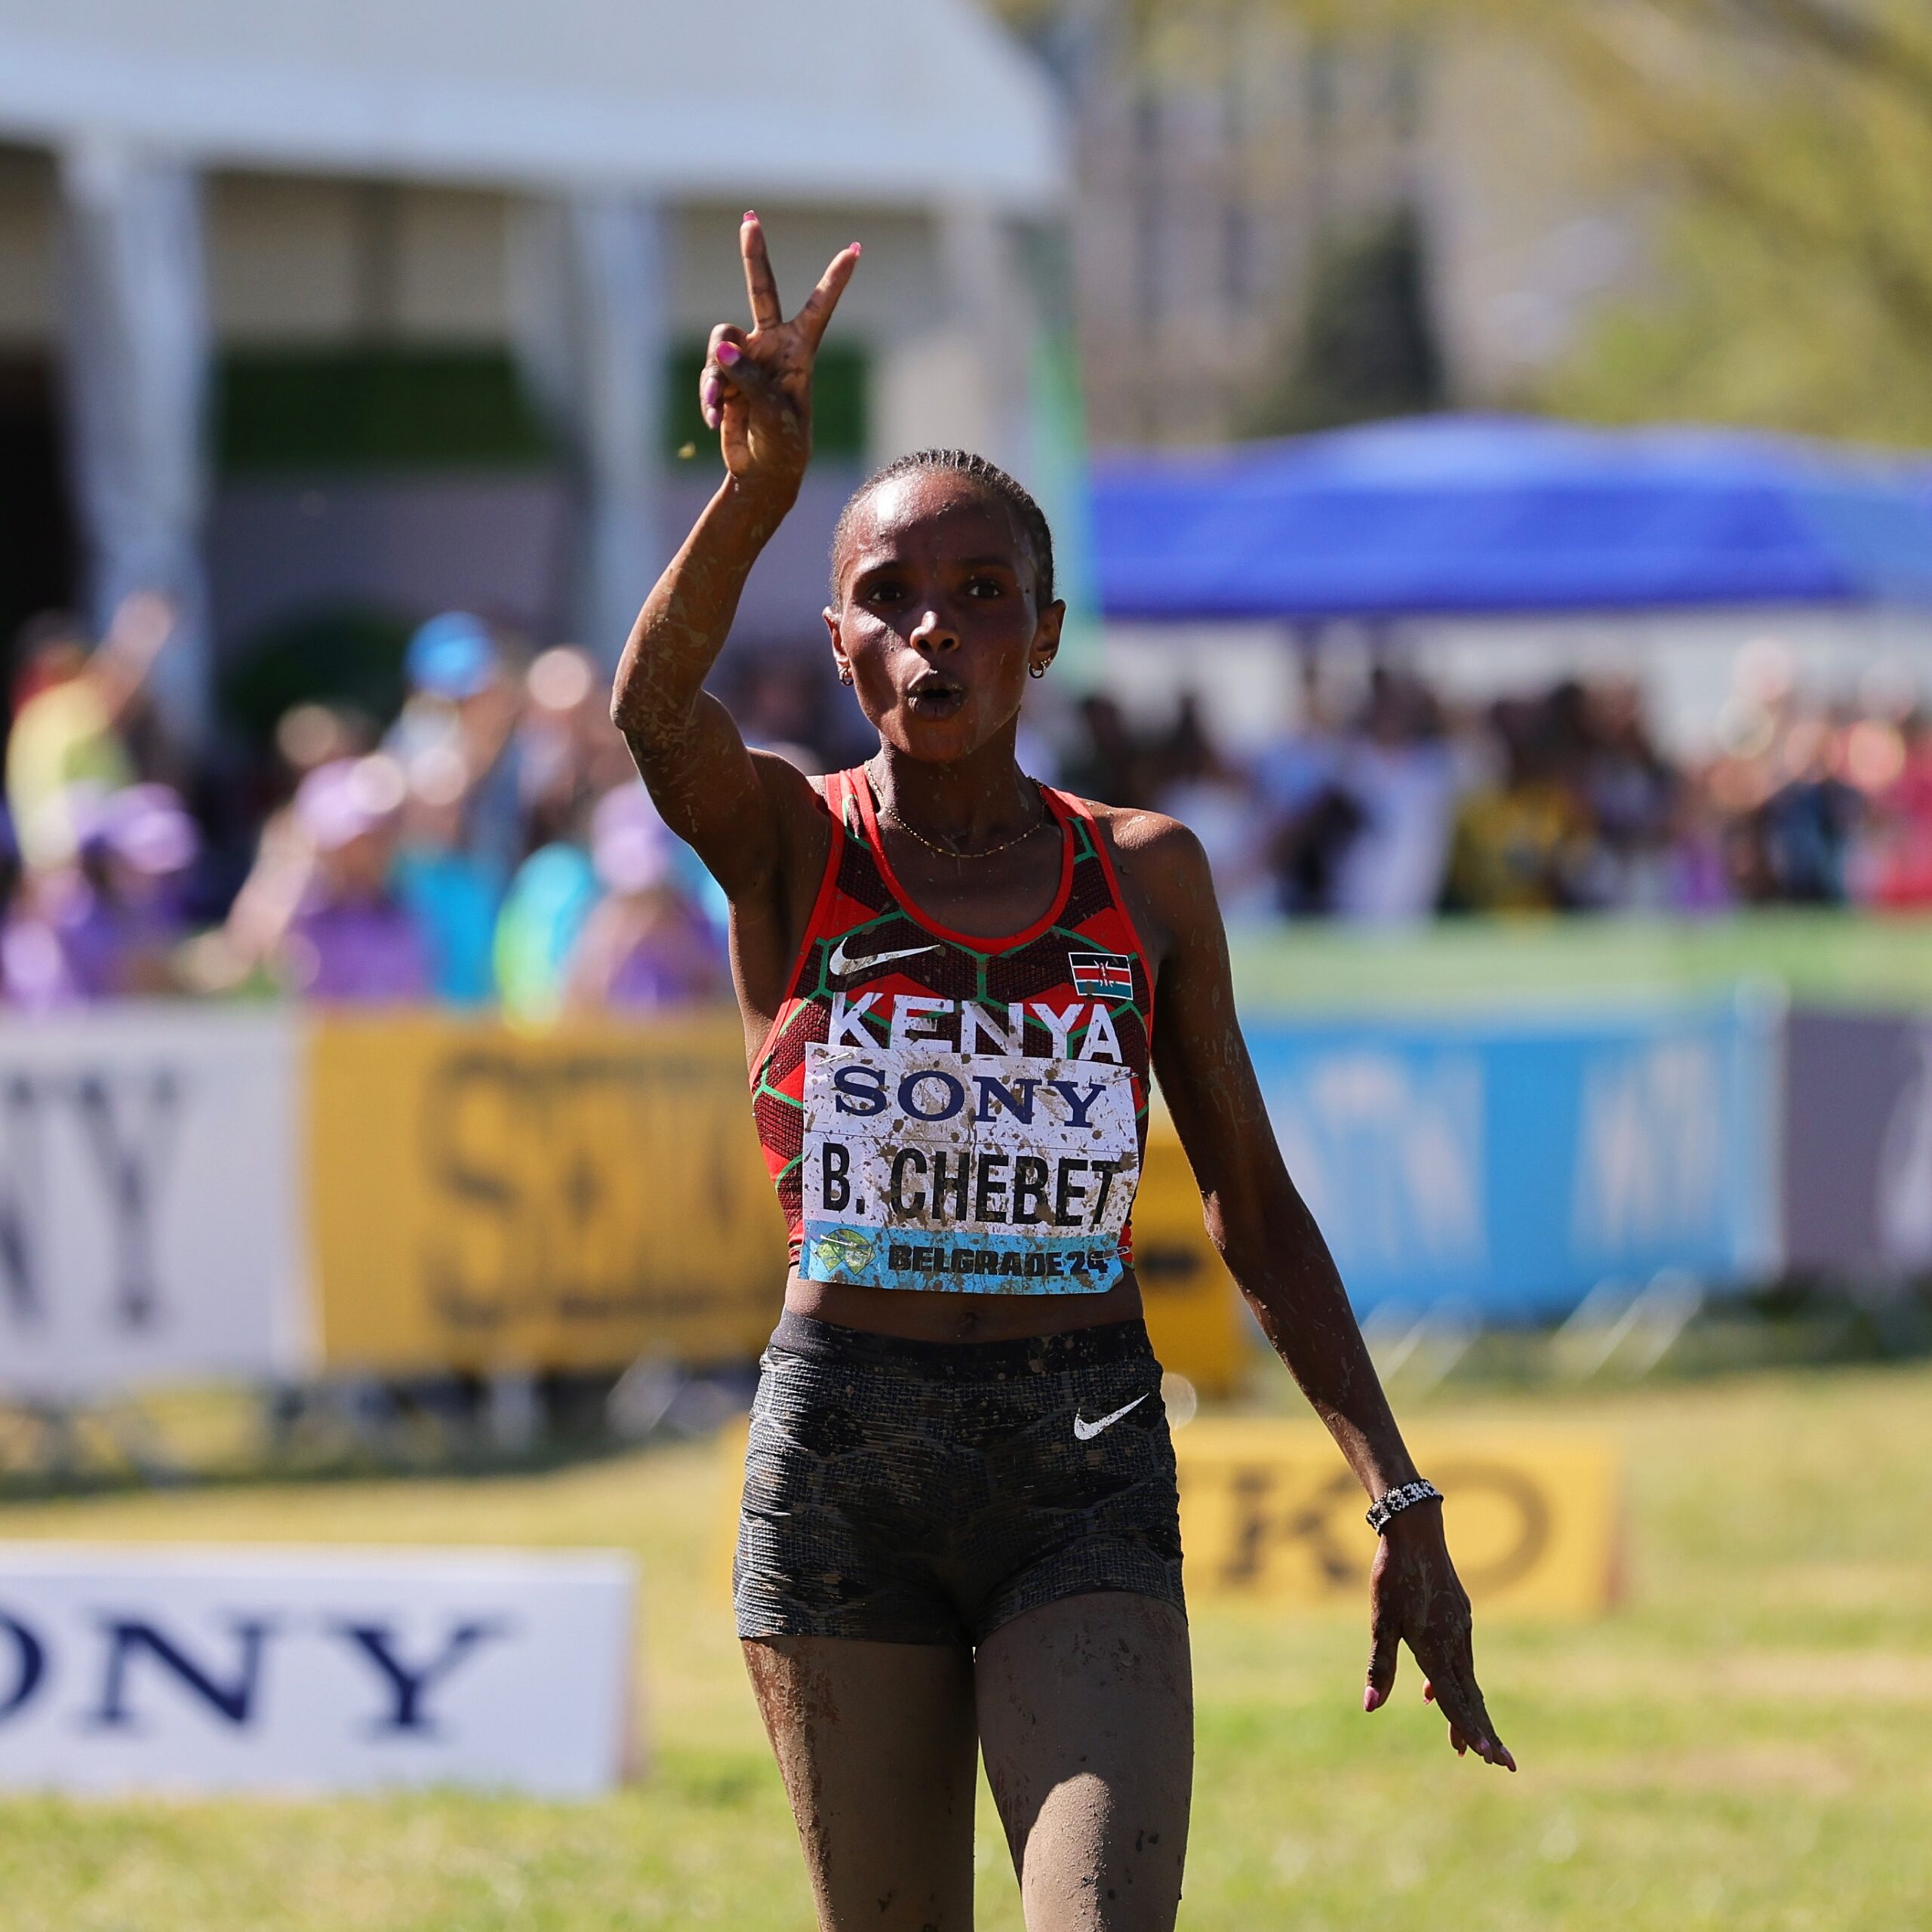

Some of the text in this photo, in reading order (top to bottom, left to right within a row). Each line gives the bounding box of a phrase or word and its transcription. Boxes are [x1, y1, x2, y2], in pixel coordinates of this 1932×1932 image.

[829, 992, 1123, 1063] KENYA
[835, 1066, 1106, 1128] SONY
[822, 1142, 1124, 1227] B. CHEBET
